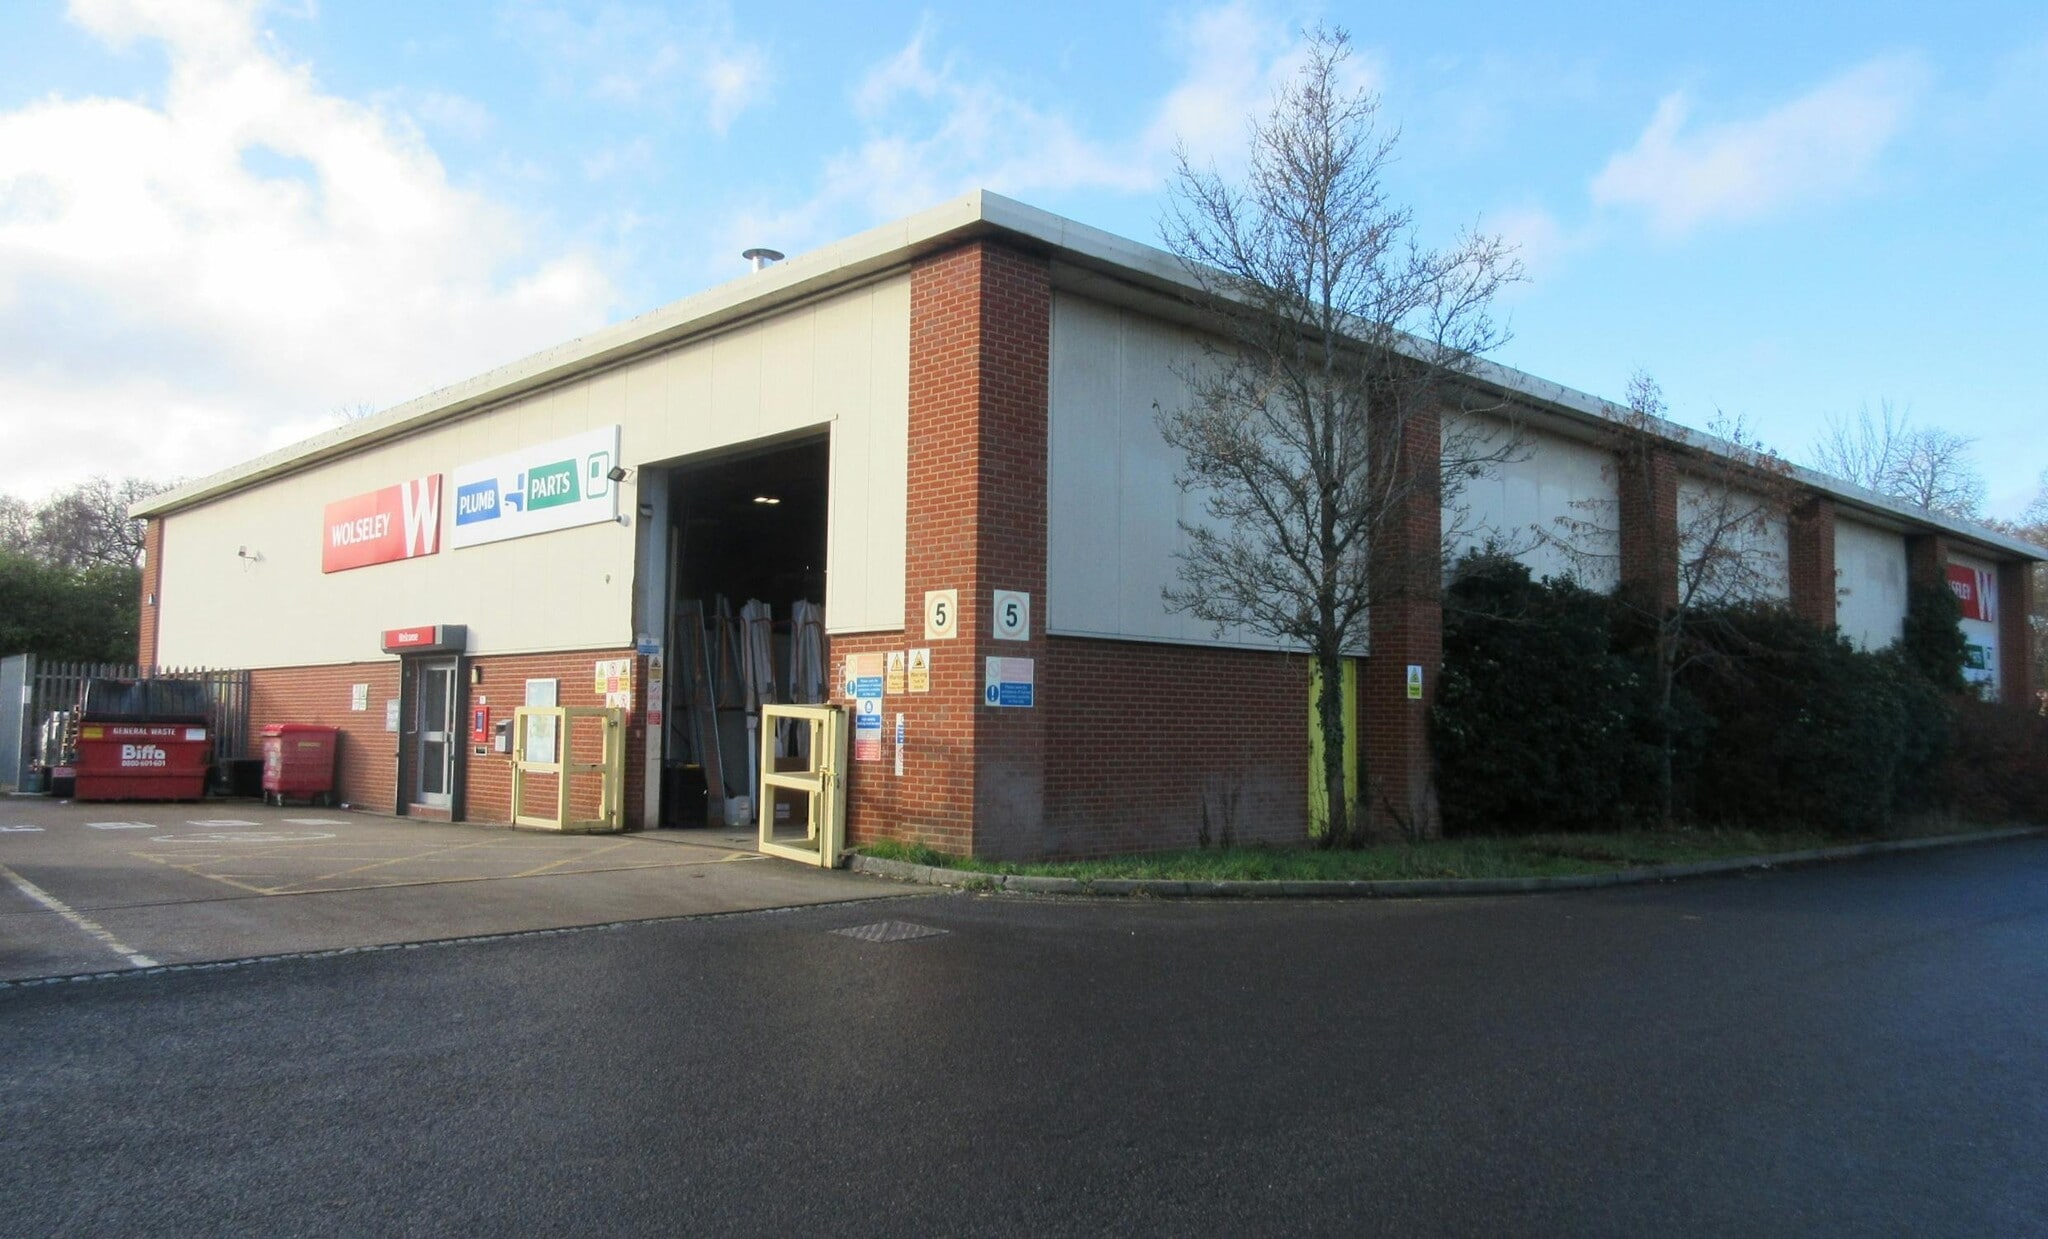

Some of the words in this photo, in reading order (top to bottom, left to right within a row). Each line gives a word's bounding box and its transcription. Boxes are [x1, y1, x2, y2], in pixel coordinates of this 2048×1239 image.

[459, 490, 495, 515] PLUMB
[531, 471, 571, 500] PARTS
[331, 512, 391, 547] WOLSELEY
[401, 474, 440, 558] W
[1974, 568, 1992, 621] W
[935, 603, 946, 626] 5
[1006, 603, 1018, 627] 5
[113, 727, 148, 735] GENERAL
[151, 728, 177, 736] WASTE
[122, 744, 166, 760] Biffa
